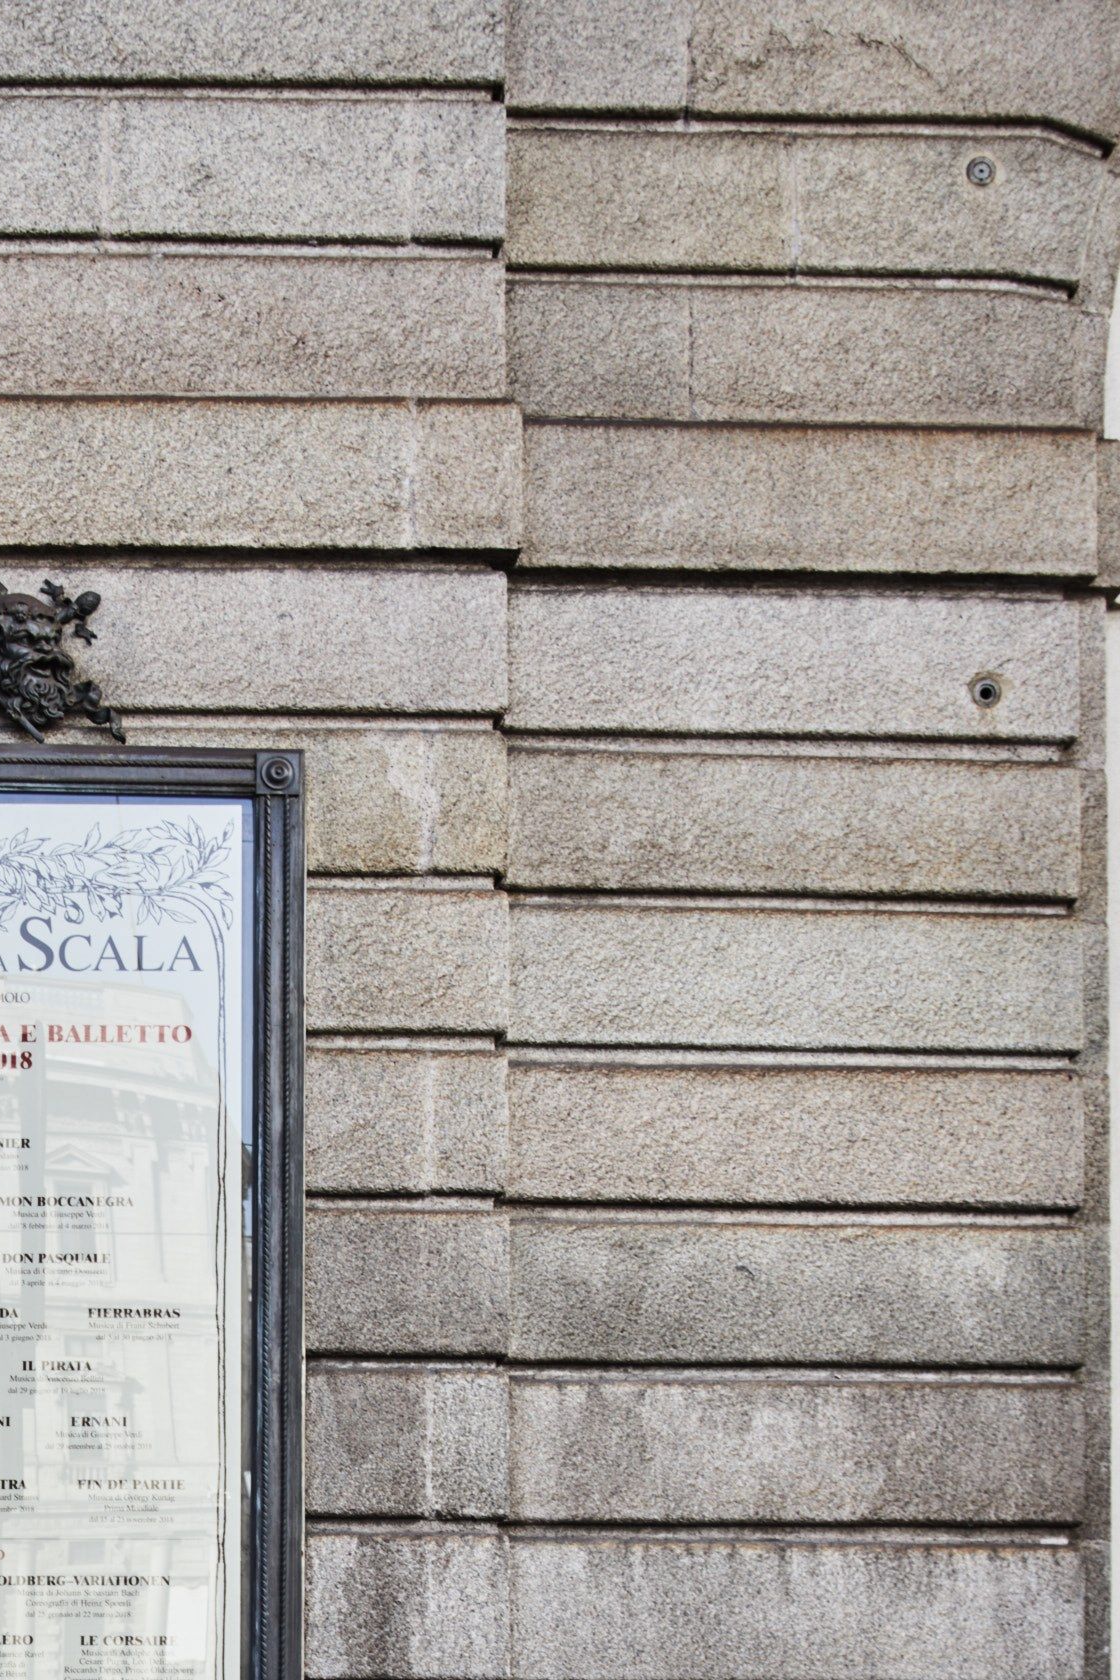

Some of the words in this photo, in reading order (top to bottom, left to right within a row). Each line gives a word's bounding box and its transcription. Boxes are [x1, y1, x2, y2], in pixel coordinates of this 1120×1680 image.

[17, 916, 202, 972] SCALA
[20, 1024, 37, 1044] E
[48, 1024, 193, 1044] BALLETTO
[36, 1196, 134, 1208] BOCCANEGRA
[2, 1252, 33, 1265] DON
[38, 1252, 111, 1265] PASQUALE
[88, 1308, 181, 1319] FIERRABRAS
[12, 1334, 34, 1343] giugno
[22, 1360, 36, 1372] IL
[41, 1360, 92, 1372] PIRATA
[71, 1416, 128, 1427] ERNANI
[77, 1479, 102, 1490] FIN
[108, 1479, 126, 1490] DE
[133, 1479, 185, 1490] PARTIE
[80, 1635, 98, 1646] LE
[103, 1635, 178, 1646] CORSAIRE
